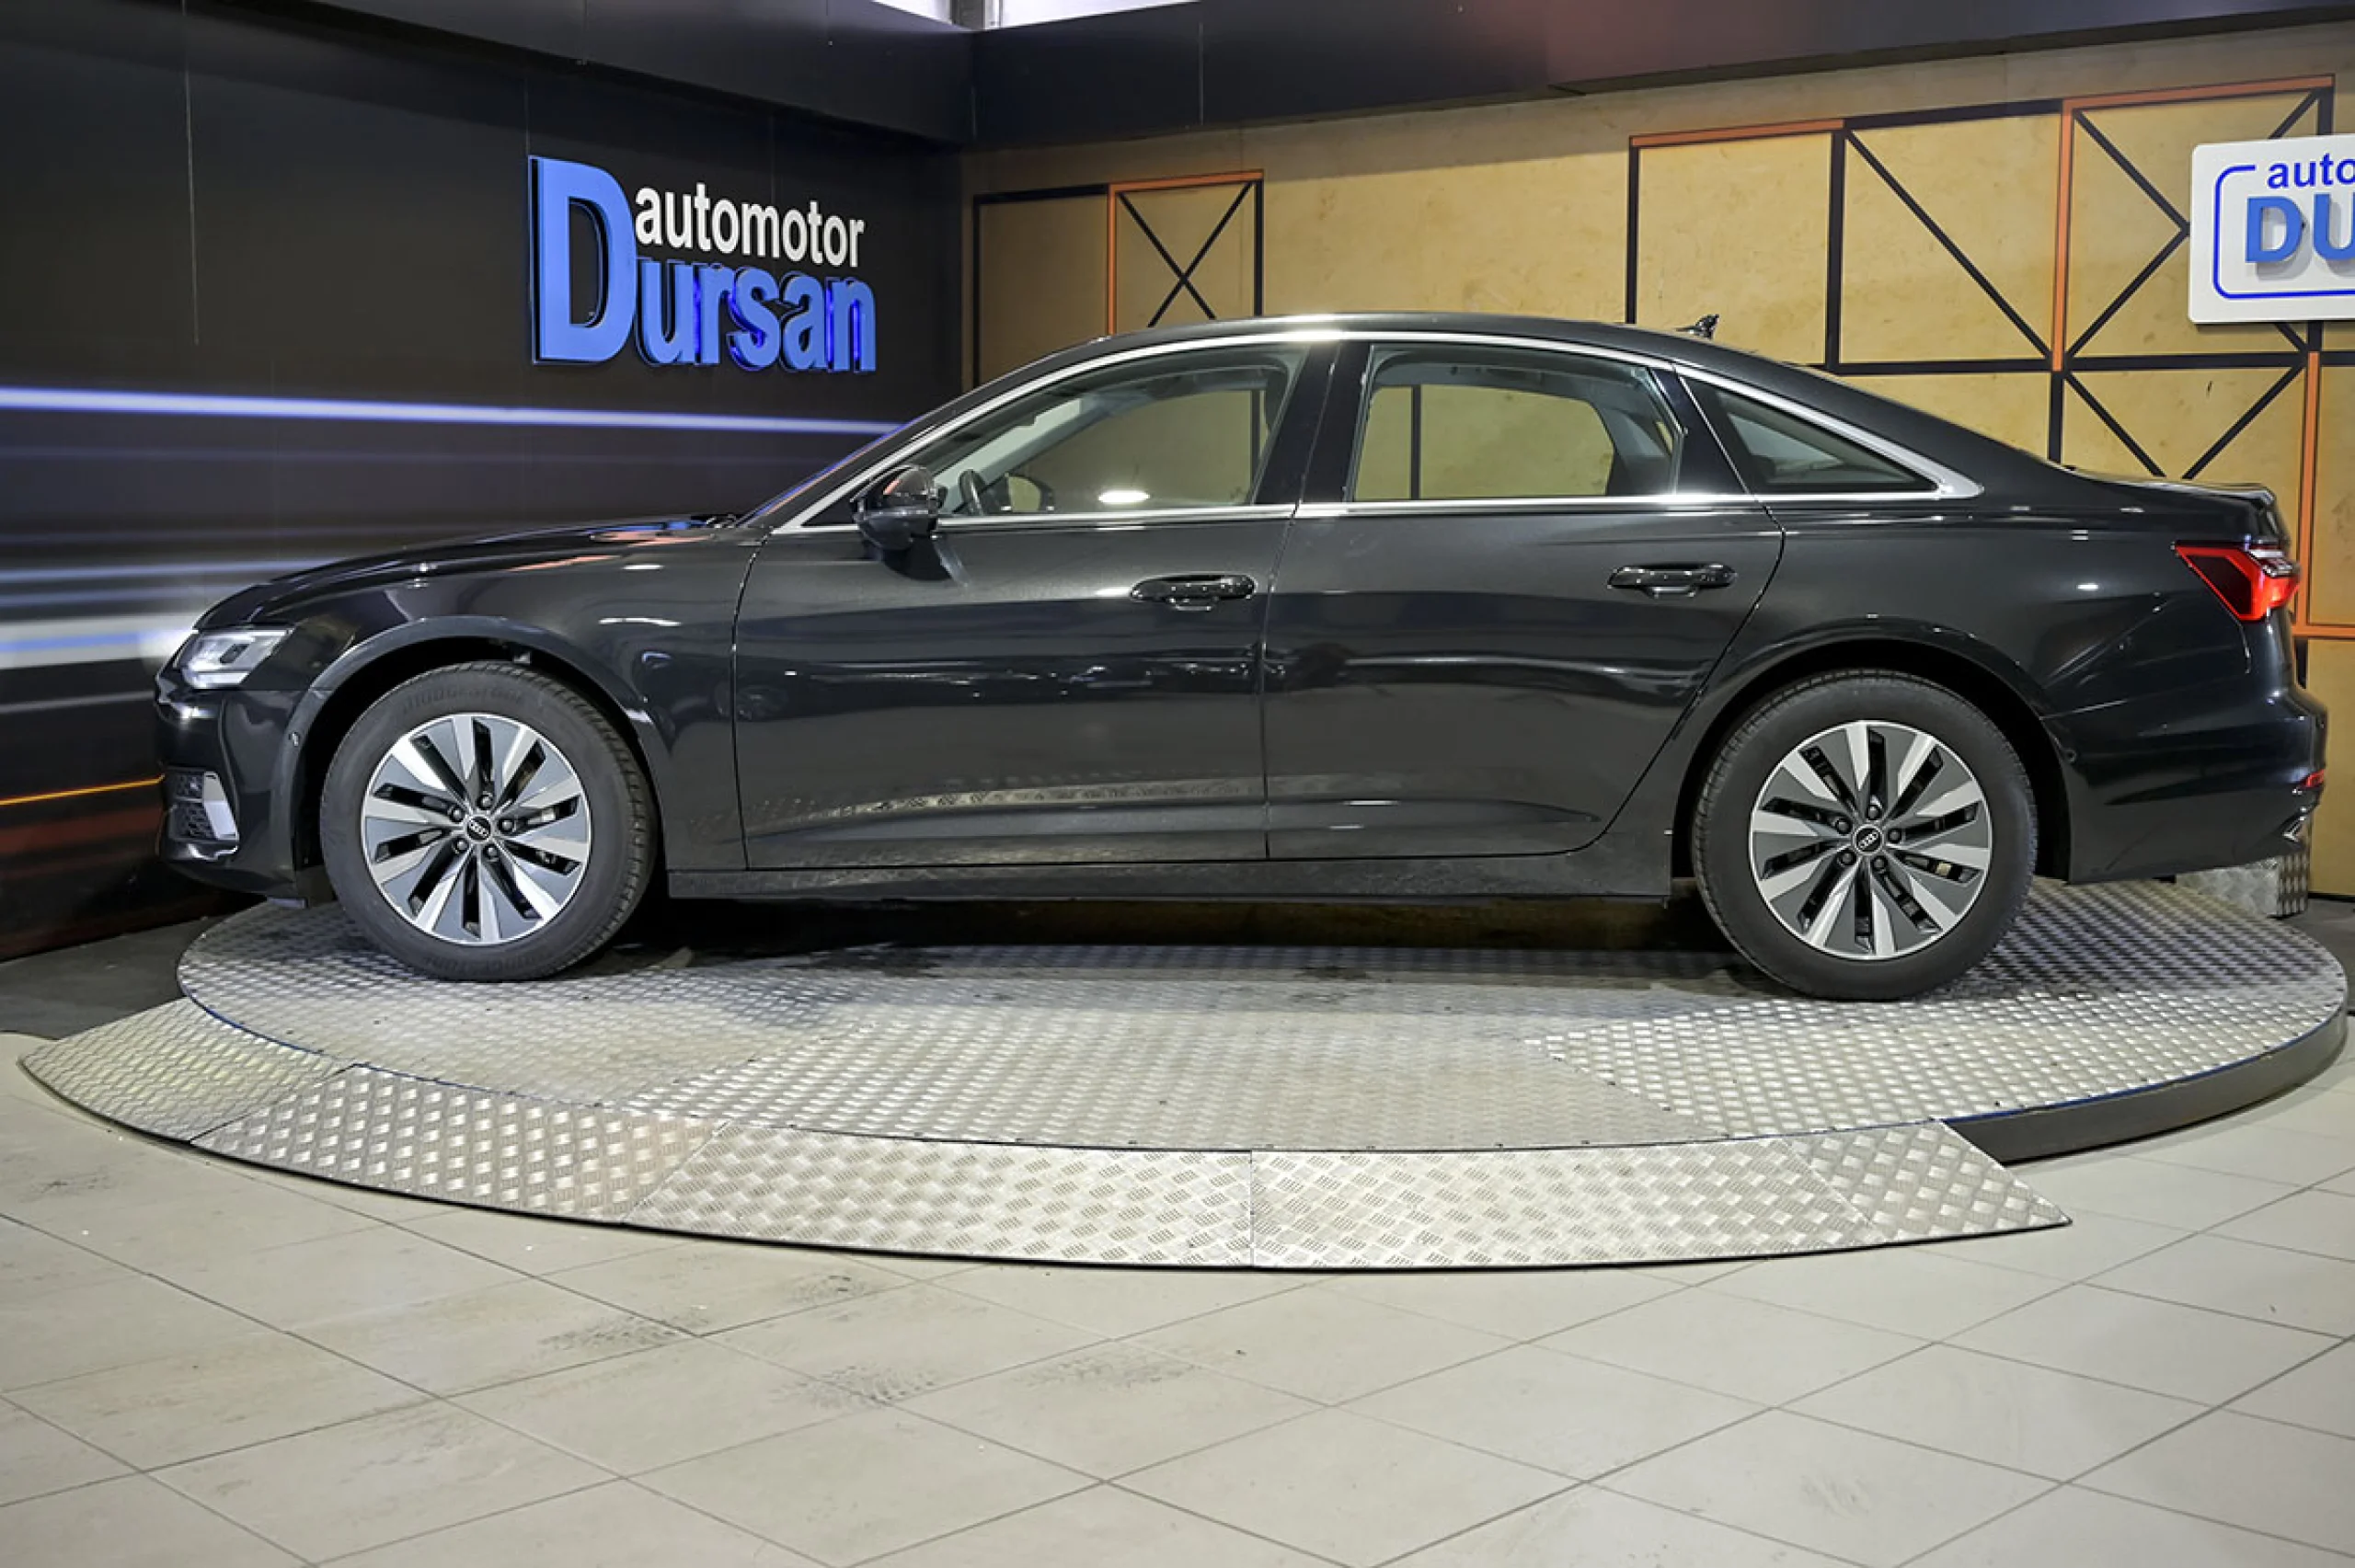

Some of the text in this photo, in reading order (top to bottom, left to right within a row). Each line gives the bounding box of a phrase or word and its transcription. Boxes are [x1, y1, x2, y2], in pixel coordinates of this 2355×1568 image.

[2267, 153, 2355, 189] auto
[529, 155, 877, 373] Dursan
[635, 182, 865, 268] automotor
